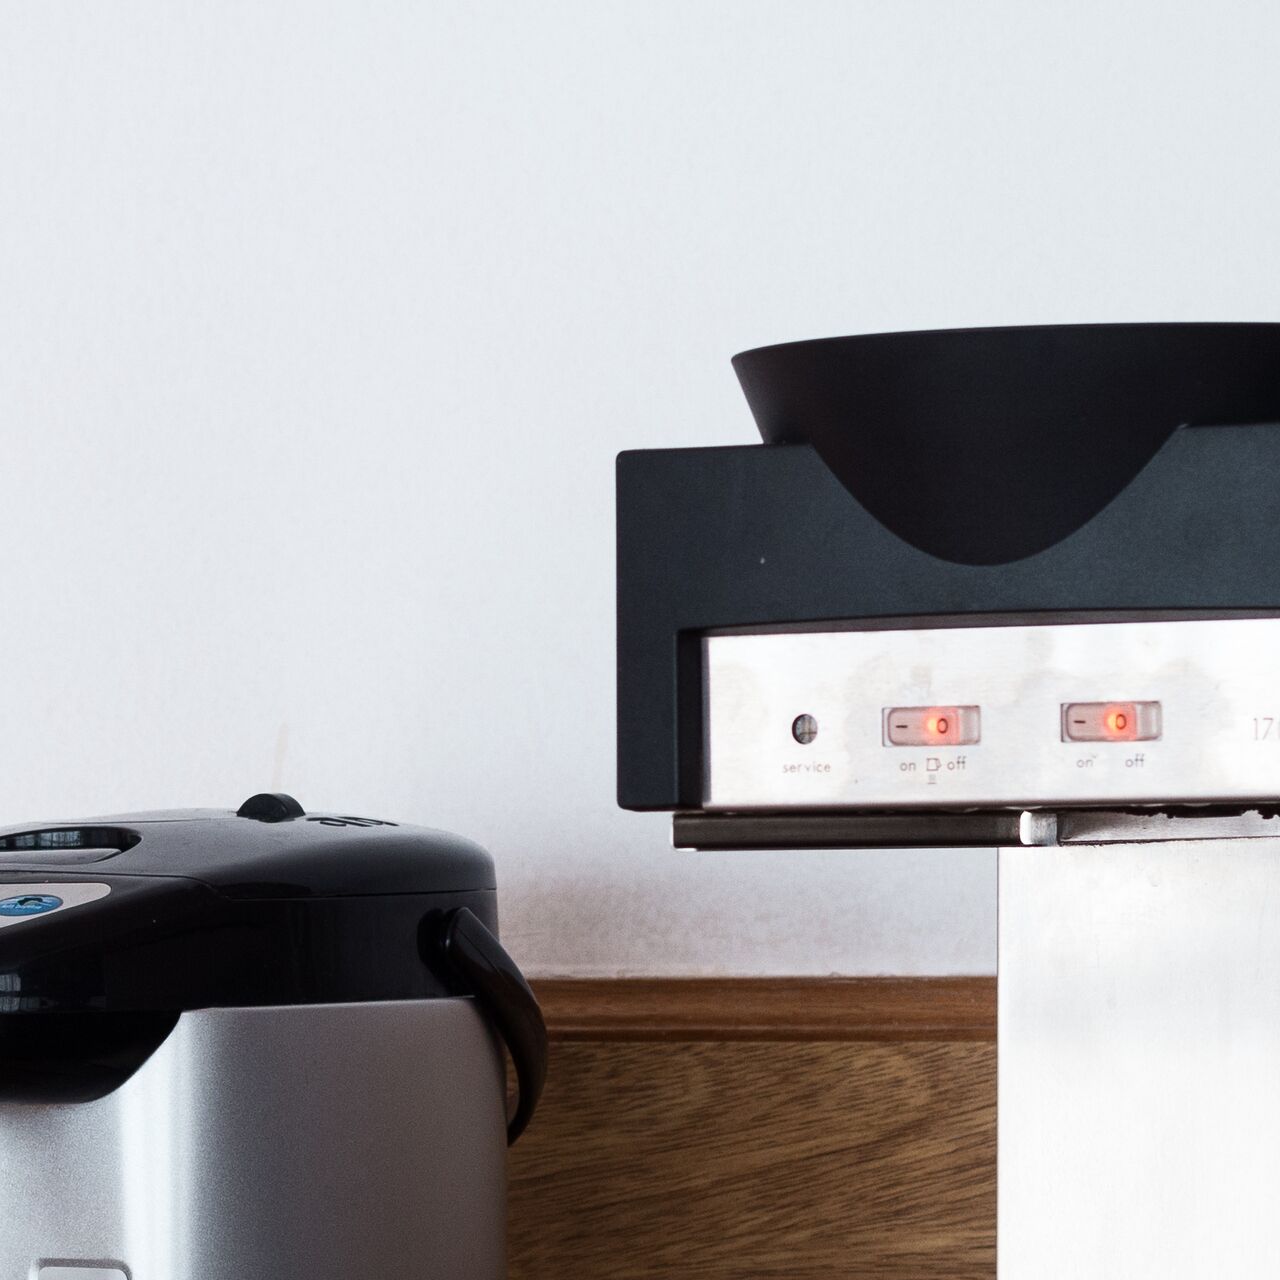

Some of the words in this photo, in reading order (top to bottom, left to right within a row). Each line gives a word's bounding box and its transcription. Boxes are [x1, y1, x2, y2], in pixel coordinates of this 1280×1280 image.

[1253, 717, 1280, 741] 17
[782, 760, 831, 774] service
[899, 760, 916, 772] on
[946, 755, 967, 771] off
[1076, 758, 1093, 768] on
[1126, 752, 1145, 767] off
